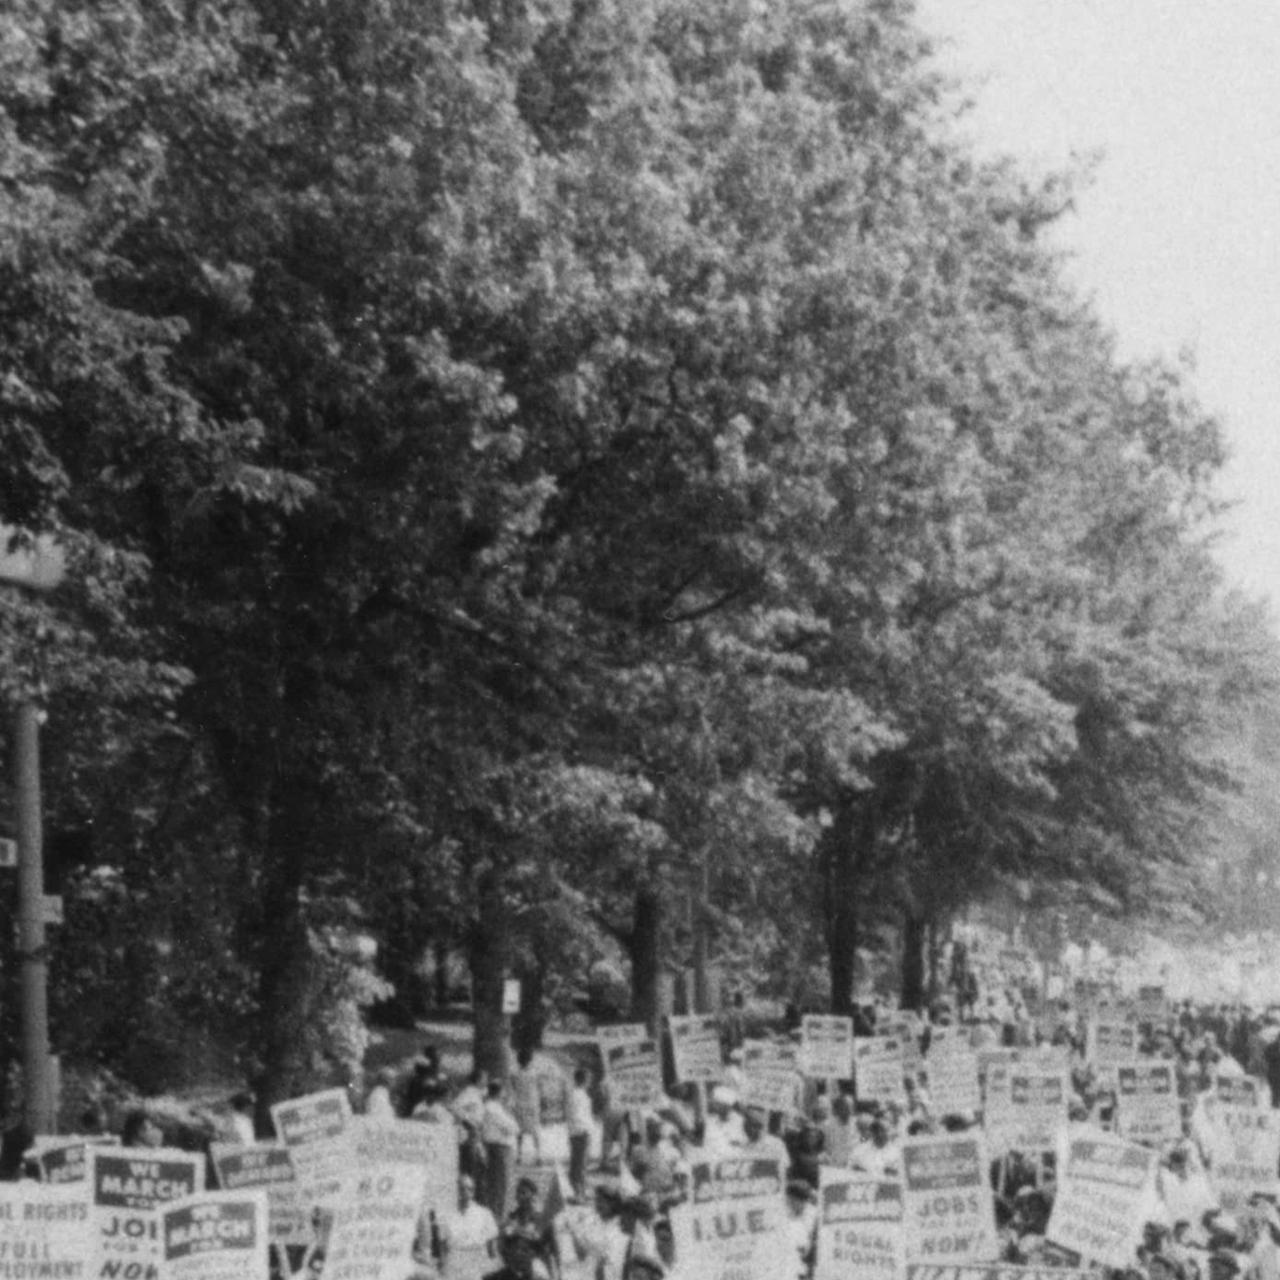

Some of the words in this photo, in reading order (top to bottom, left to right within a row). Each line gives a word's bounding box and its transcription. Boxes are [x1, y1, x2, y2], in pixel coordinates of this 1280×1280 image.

[129, 1161, 161, 1177] WE
[101, 1176, 189, 1198] MARCH
[24, 1202, 88, 1221] RIGHTS
[102, 1216, 157, 1240] JO
